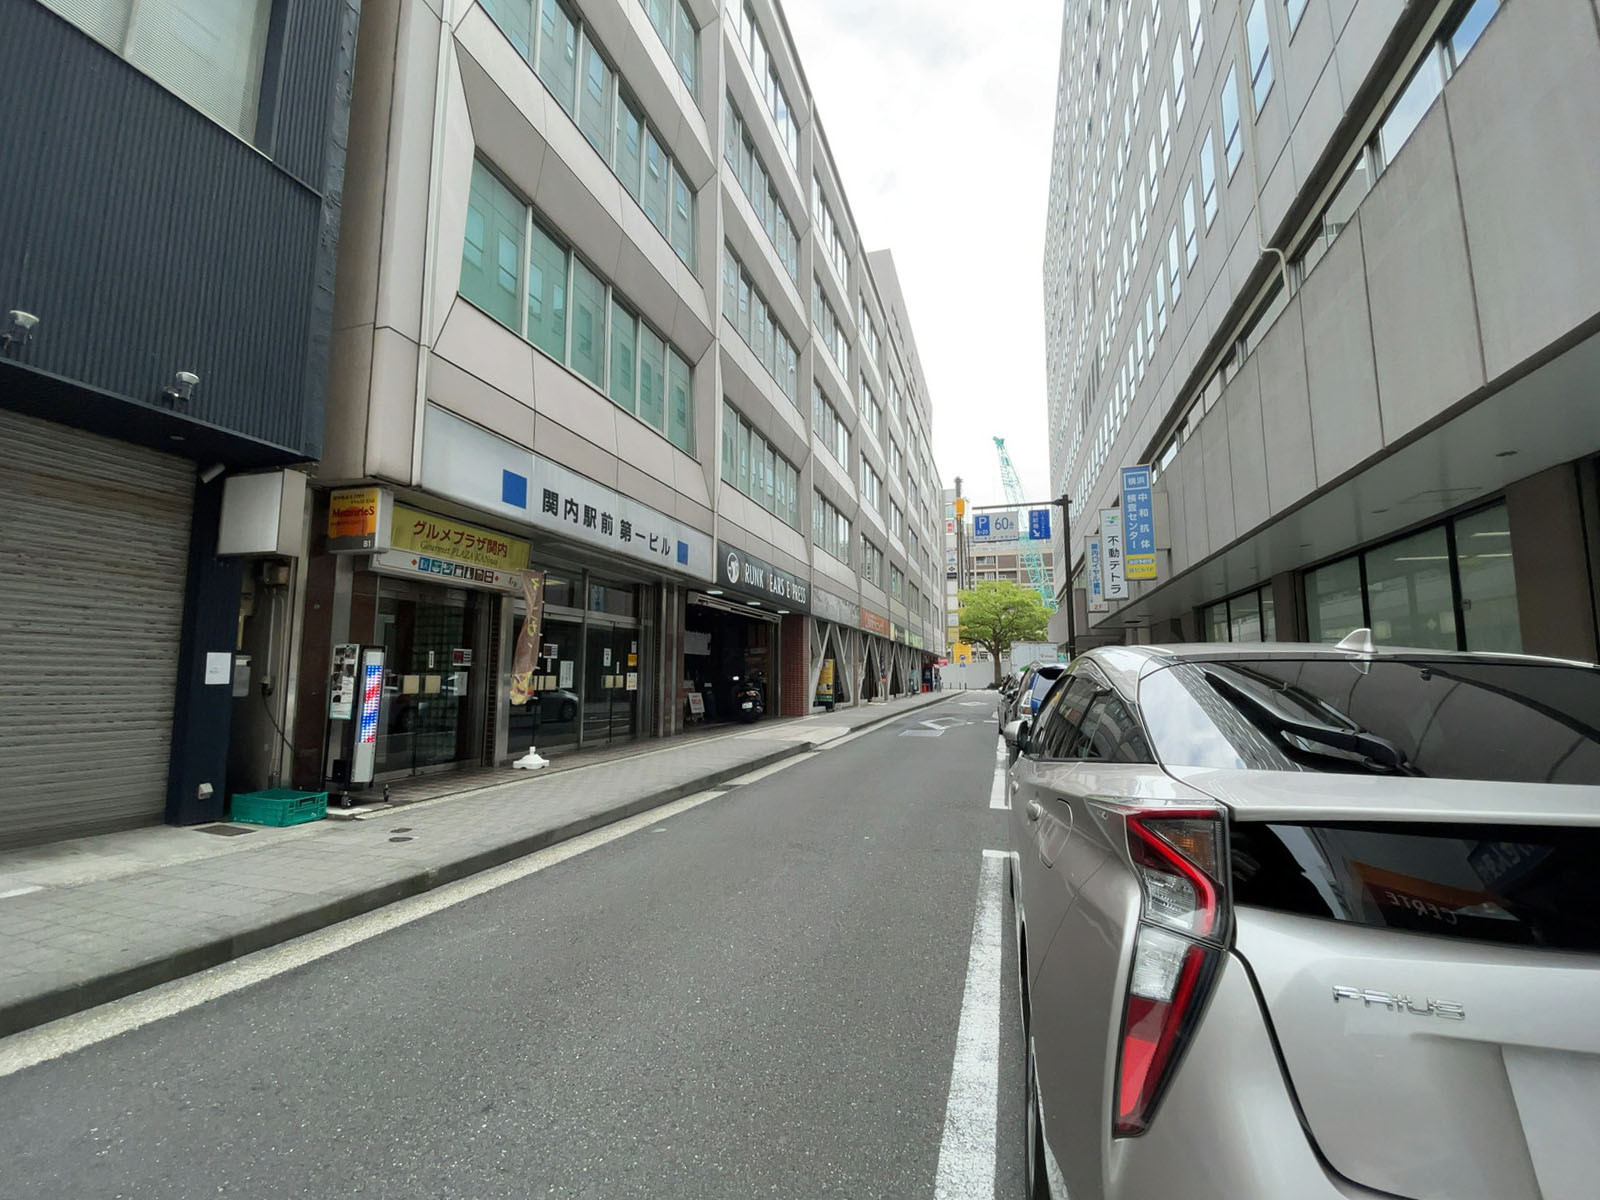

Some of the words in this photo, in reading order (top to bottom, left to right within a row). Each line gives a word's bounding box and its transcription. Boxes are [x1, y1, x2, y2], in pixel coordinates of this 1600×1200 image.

[542, 488, 671, 557] 関内駅前第一ビル
[978, 517, 987, 529] P
[1138, 493, 1151, 549] 中和抗体
[1107, 535, 1122, 595] 不動テトラ
[1332, 985, 1466, 1021] PRIUS
